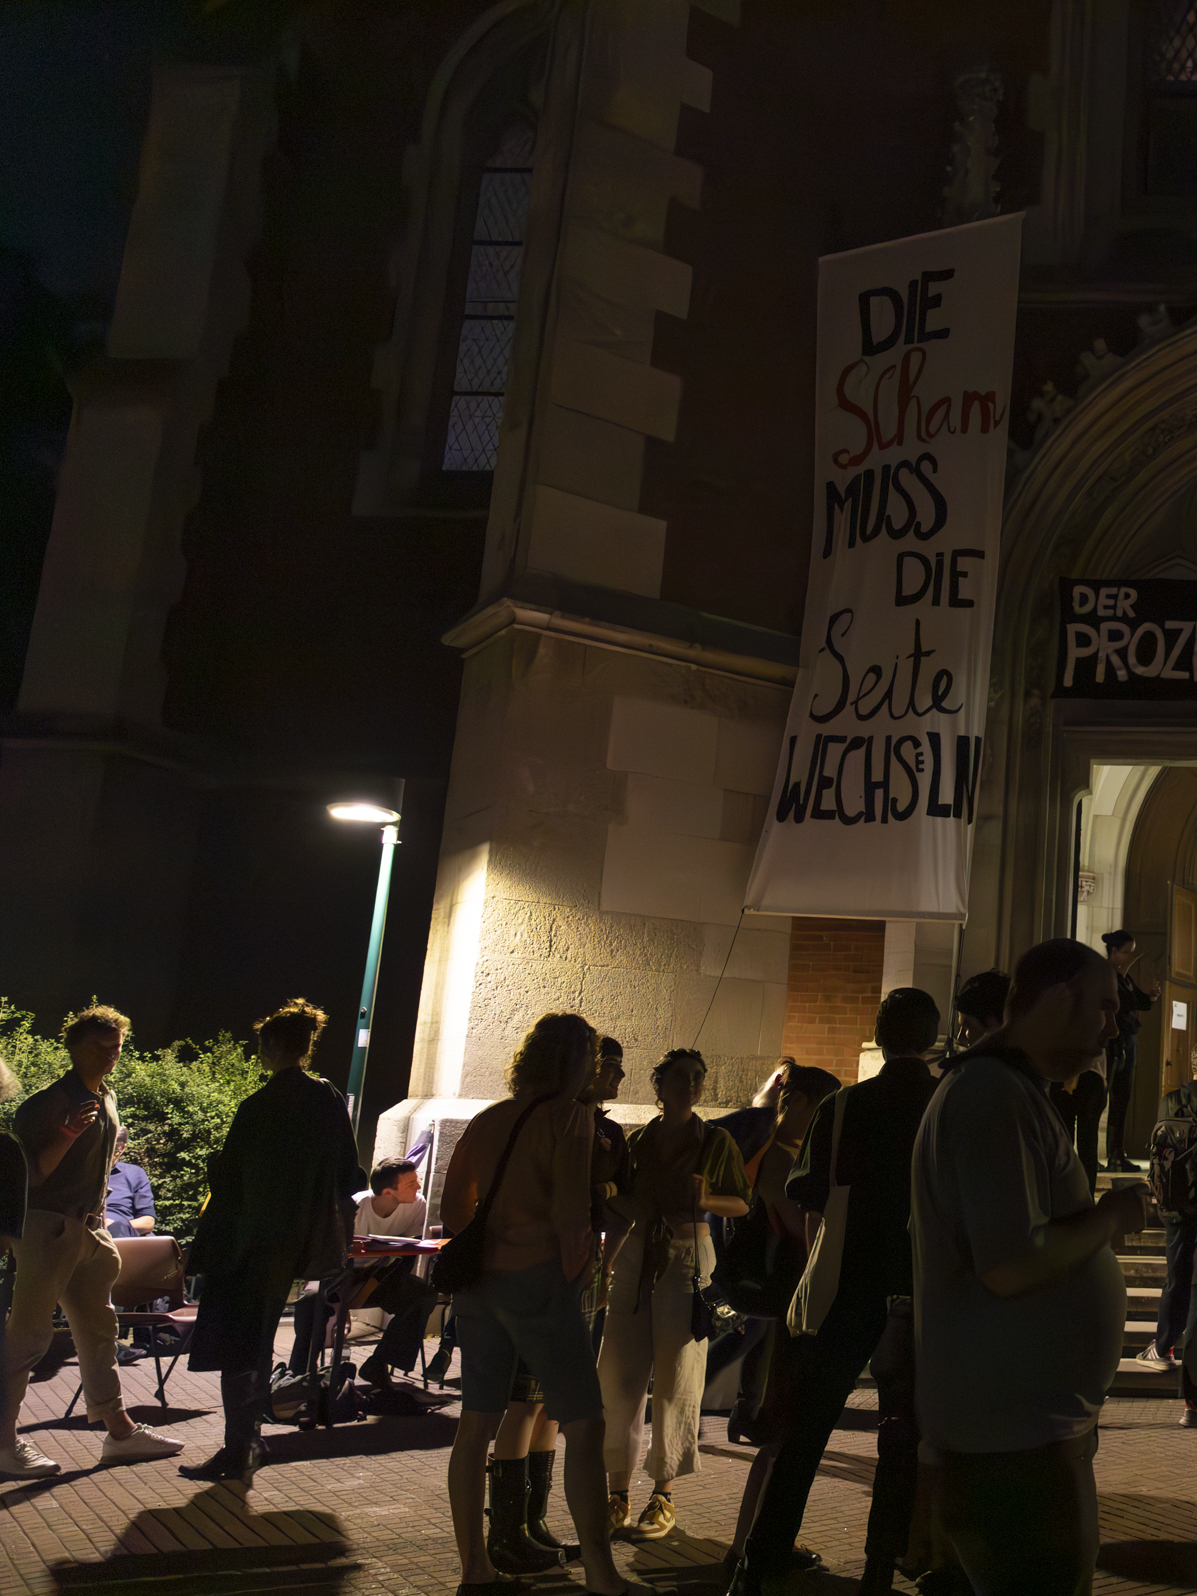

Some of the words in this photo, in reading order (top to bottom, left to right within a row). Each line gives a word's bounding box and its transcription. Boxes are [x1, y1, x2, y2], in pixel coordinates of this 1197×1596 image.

[859, 268, 955, 357] DIE
[822, 452, 947, 559] MUSS
[895, 549, 985, 607] DIE
[1072, 585, 1138, 618] DER
[809, 608, 963, 723] Seite
[776, 732, 981, 825] WECHSELN
